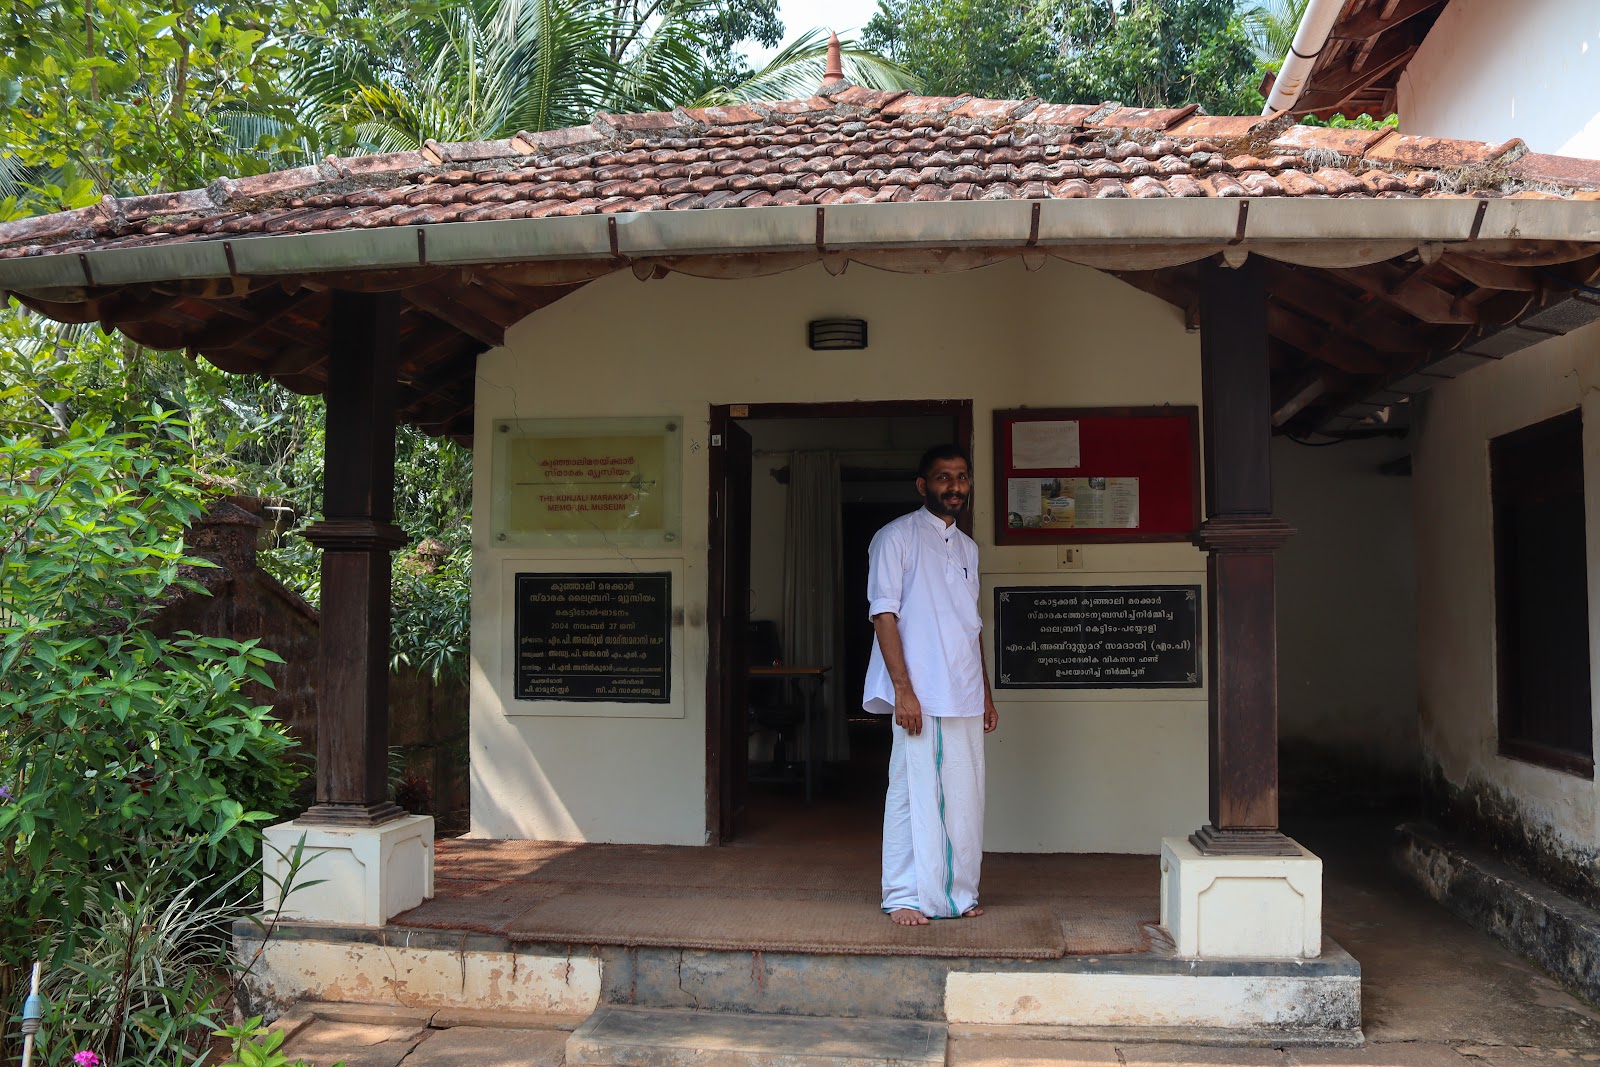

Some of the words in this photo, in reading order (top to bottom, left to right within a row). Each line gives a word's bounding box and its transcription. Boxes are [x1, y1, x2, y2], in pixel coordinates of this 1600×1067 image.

[544, 468, 583, 477] സ്മാരക
[587, 467, 630, 479] മ്യൂസിയം
[556, 494, 589, 502] KUNJALI
[591, 503, 626, 511] MUSEUM
[551, 581, 595, 592] കുഞ്ഞാലി
[598, 581, 634, 590] മരക്കാർ
[529, 593, 565, 602] സ്മാരക
[1033, 597, 1078, 607] കോട്ടക്കൽ
[1081, 596, 1125, 608] കുഞ്ഞാലി
[1128, 596, 1162, 605] മരക്കാർ
[551, 622, 569, 630] 2004
[573, 621, 605, 630] നവംബർ
[608, 622, 617, 630] 27
[620, 621, 636, 630] ശനി
[1040, 624, 1082, 634] ലൈബ്രറി
[1105, 640, 1147, 651] സമദാനി
[1150, 639, 1191, 652] (എം.പി)
[1102, 655, 1136, 664] വികസന
[1138, 654, 1159, 664] ഫണ്ട്
[1055, 666, 1101, 677] ഉപയോഗിച്ച്
